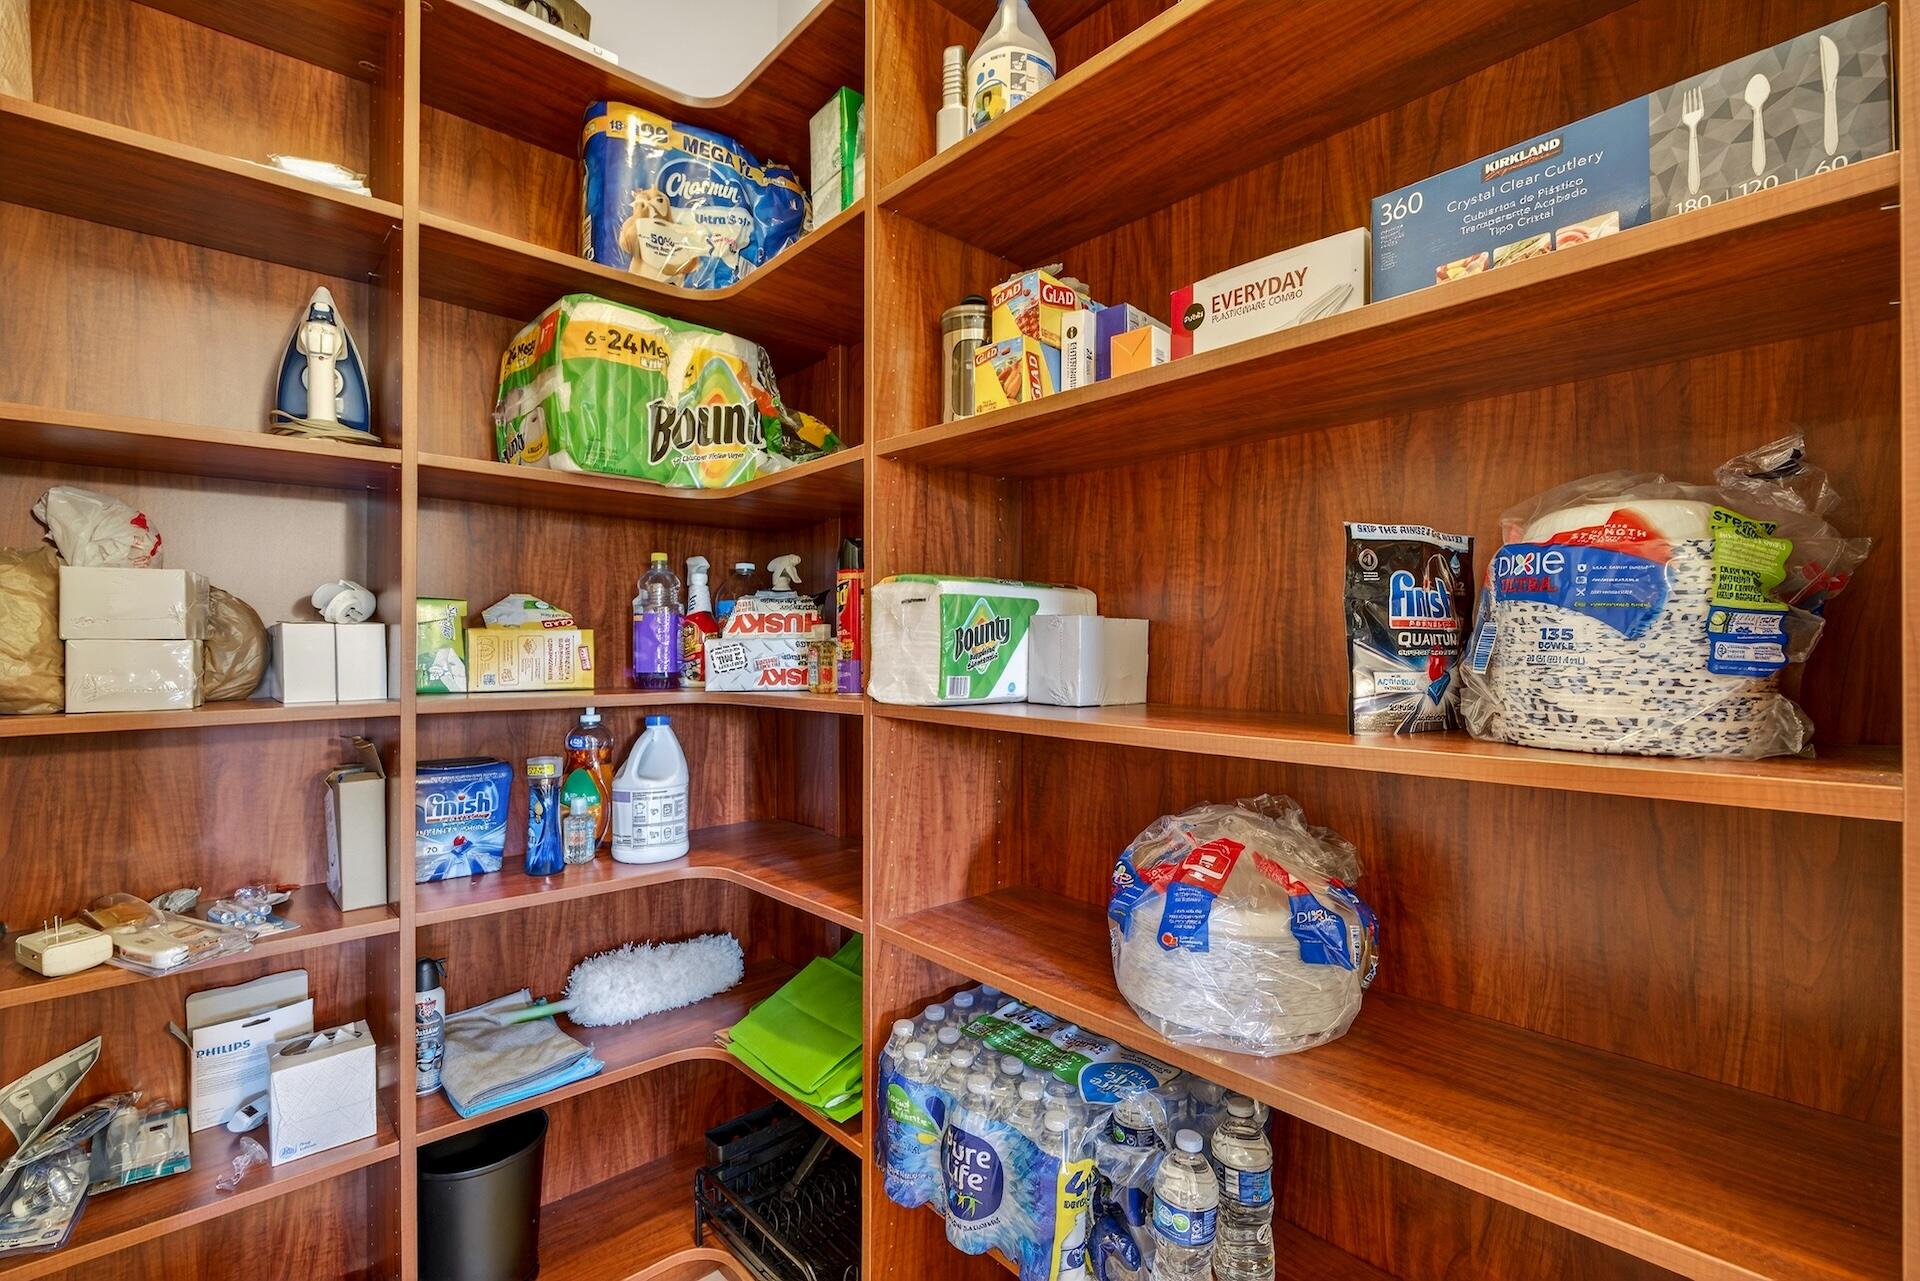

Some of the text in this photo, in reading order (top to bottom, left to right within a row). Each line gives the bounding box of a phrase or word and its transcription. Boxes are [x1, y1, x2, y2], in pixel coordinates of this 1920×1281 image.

[683, 135, 736, 168] MEGA
[1485, 138, 1561, 174] KIRKLAND
[665, 171, 741, 203] Charmin
[1446, 150, 1605, 213] Crystal Clear Cutlery
[1738, 174, 1779, 197] 120
[1380, 191, 1423, 226] 360
[1674, 194, 1712, 215] 180
[1489, 223, 1514, 237] Tipo
[993, 280, 1022, 306] GLAD
[1042, 284, 1074, 306] GLAD
[1211, 266, 1308, 314] EVERYDAY
[1268, 289, 1303, 306] COMBO
[585, 331, 596, 345] 6
[608, 329, 638, 354] 24
[975, 346, 998, 367] GLAD
[1379, 526, 1398, 534] THE
[728, 612, 823, 634] HUSKY
[1539, 627, 1575, 641] 135
[954, 614, 1011, 661] Bounty
[425, 791, 491, 818] finish
[196, 1039, 251, 1059] PHILIPS
